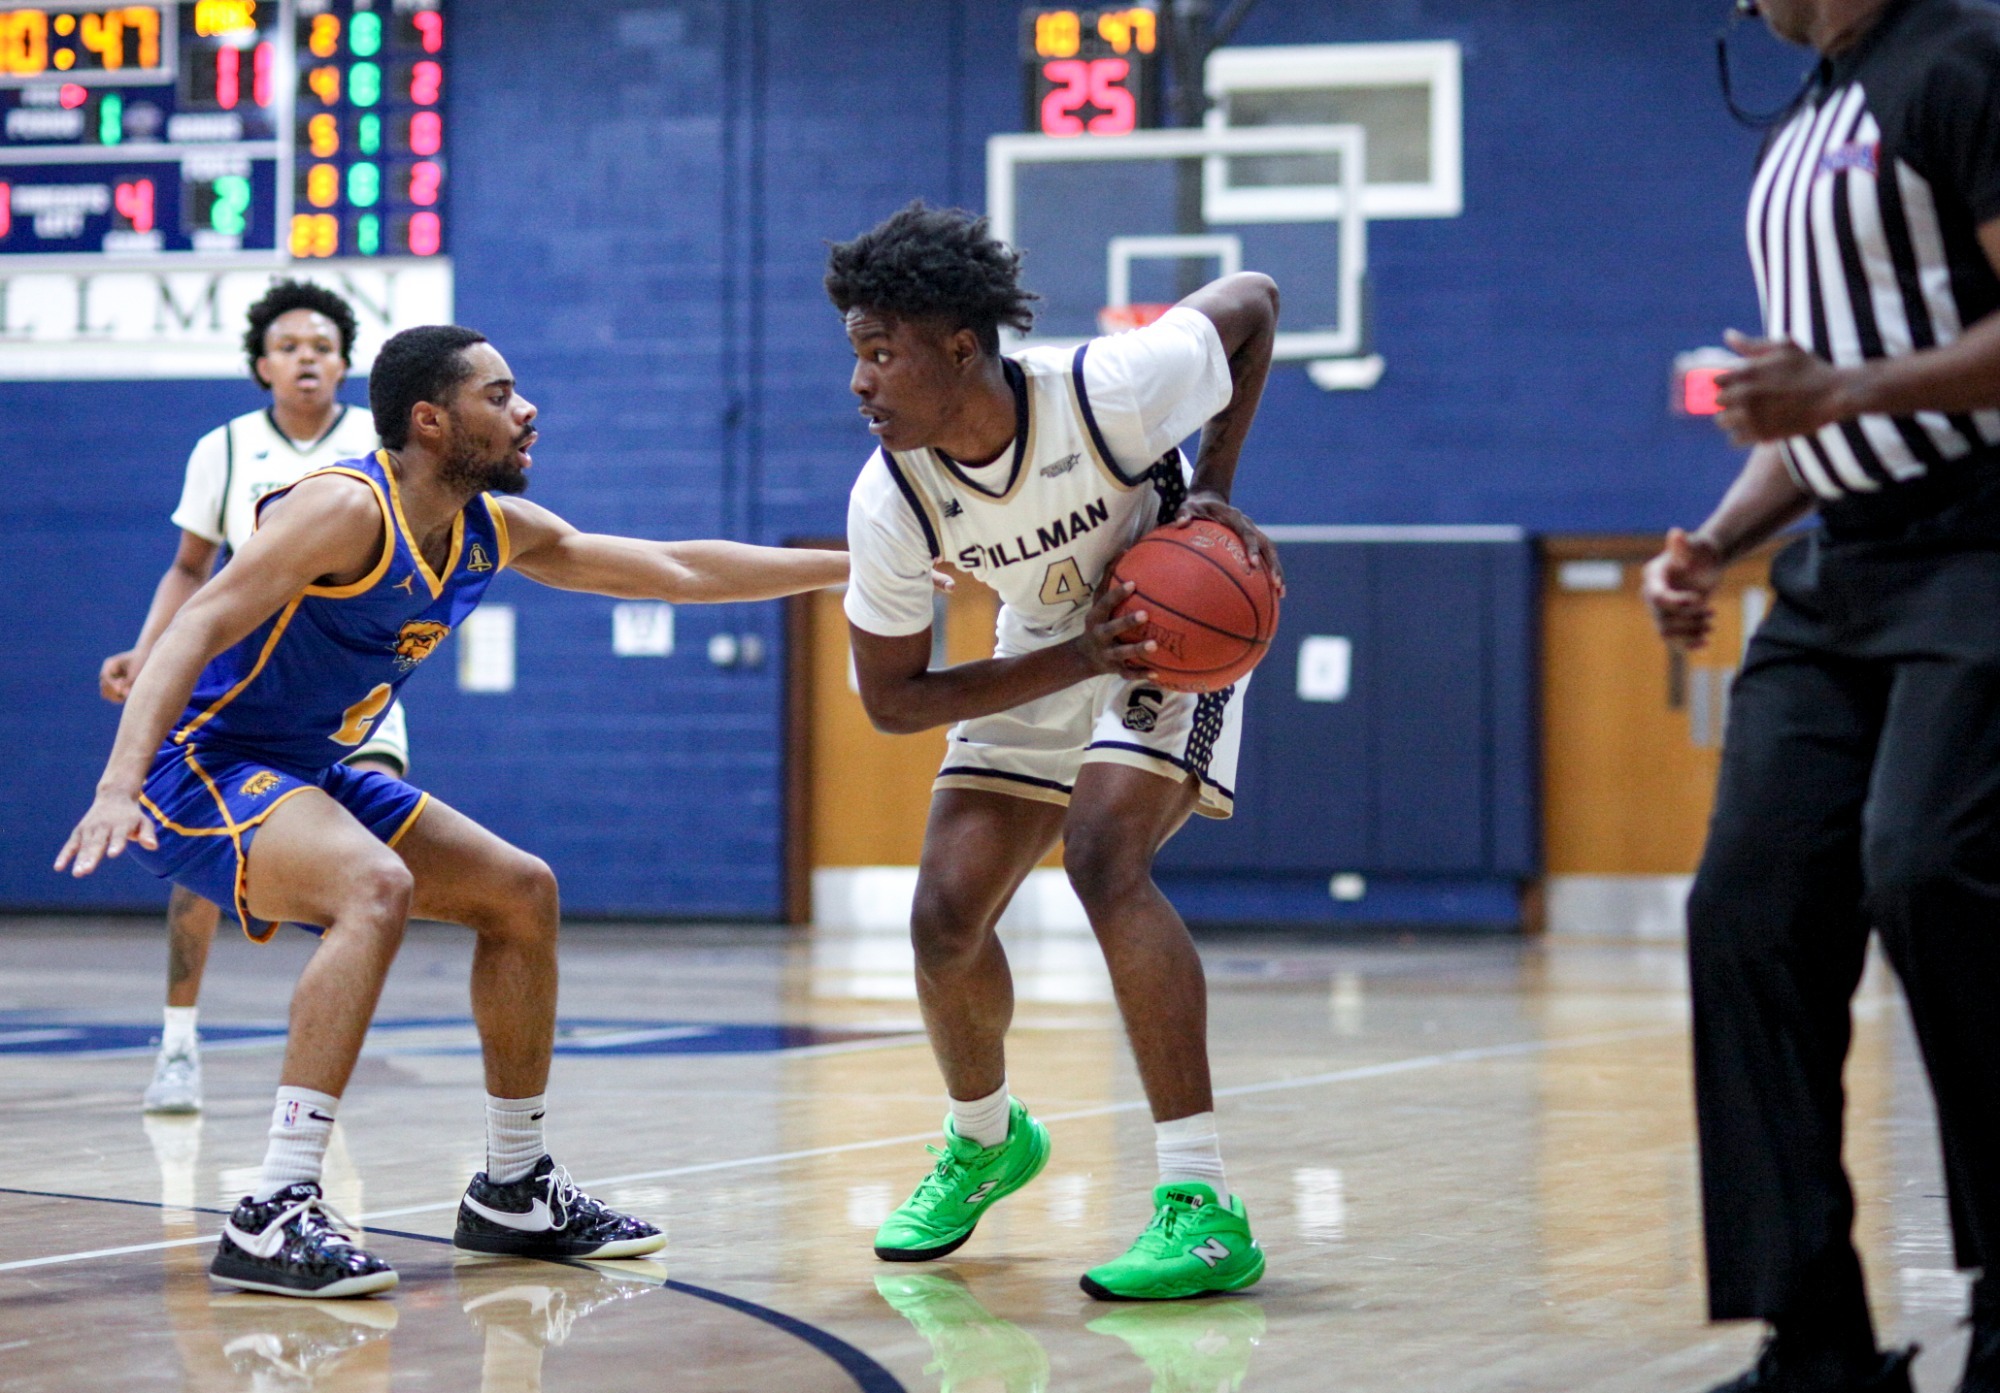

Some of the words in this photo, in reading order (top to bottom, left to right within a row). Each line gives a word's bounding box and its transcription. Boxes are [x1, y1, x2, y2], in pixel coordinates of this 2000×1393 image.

[216, 42, 275, 109] 11
[1042, 58, 1136, 138] 25
[100, 93, 122, 146] 1
[115, 178, 153, 233] 4
[211, 176, 250, 235] 2
[958, 497, 1110, 569] SILLMAN
[1038, 556, 1094, 609] 4
